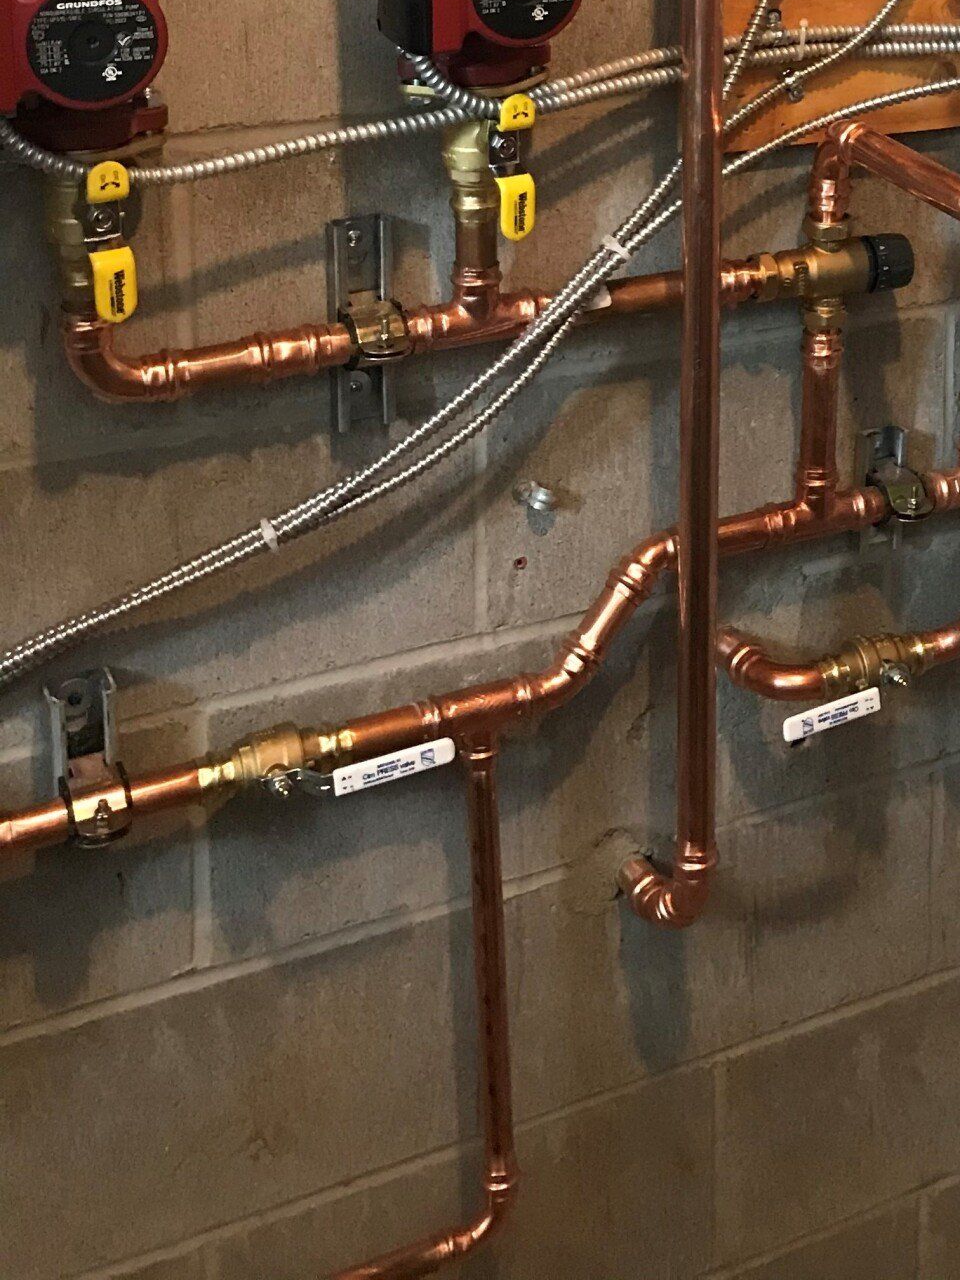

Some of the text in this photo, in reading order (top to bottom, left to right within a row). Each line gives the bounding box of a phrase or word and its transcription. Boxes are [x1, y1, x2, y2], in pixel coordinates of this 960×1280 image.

[56, 0, 122, 10] GRUNDFOS
[518, 192, 527, 232] Webstone
[114, 270, 125, 314] Webstone
